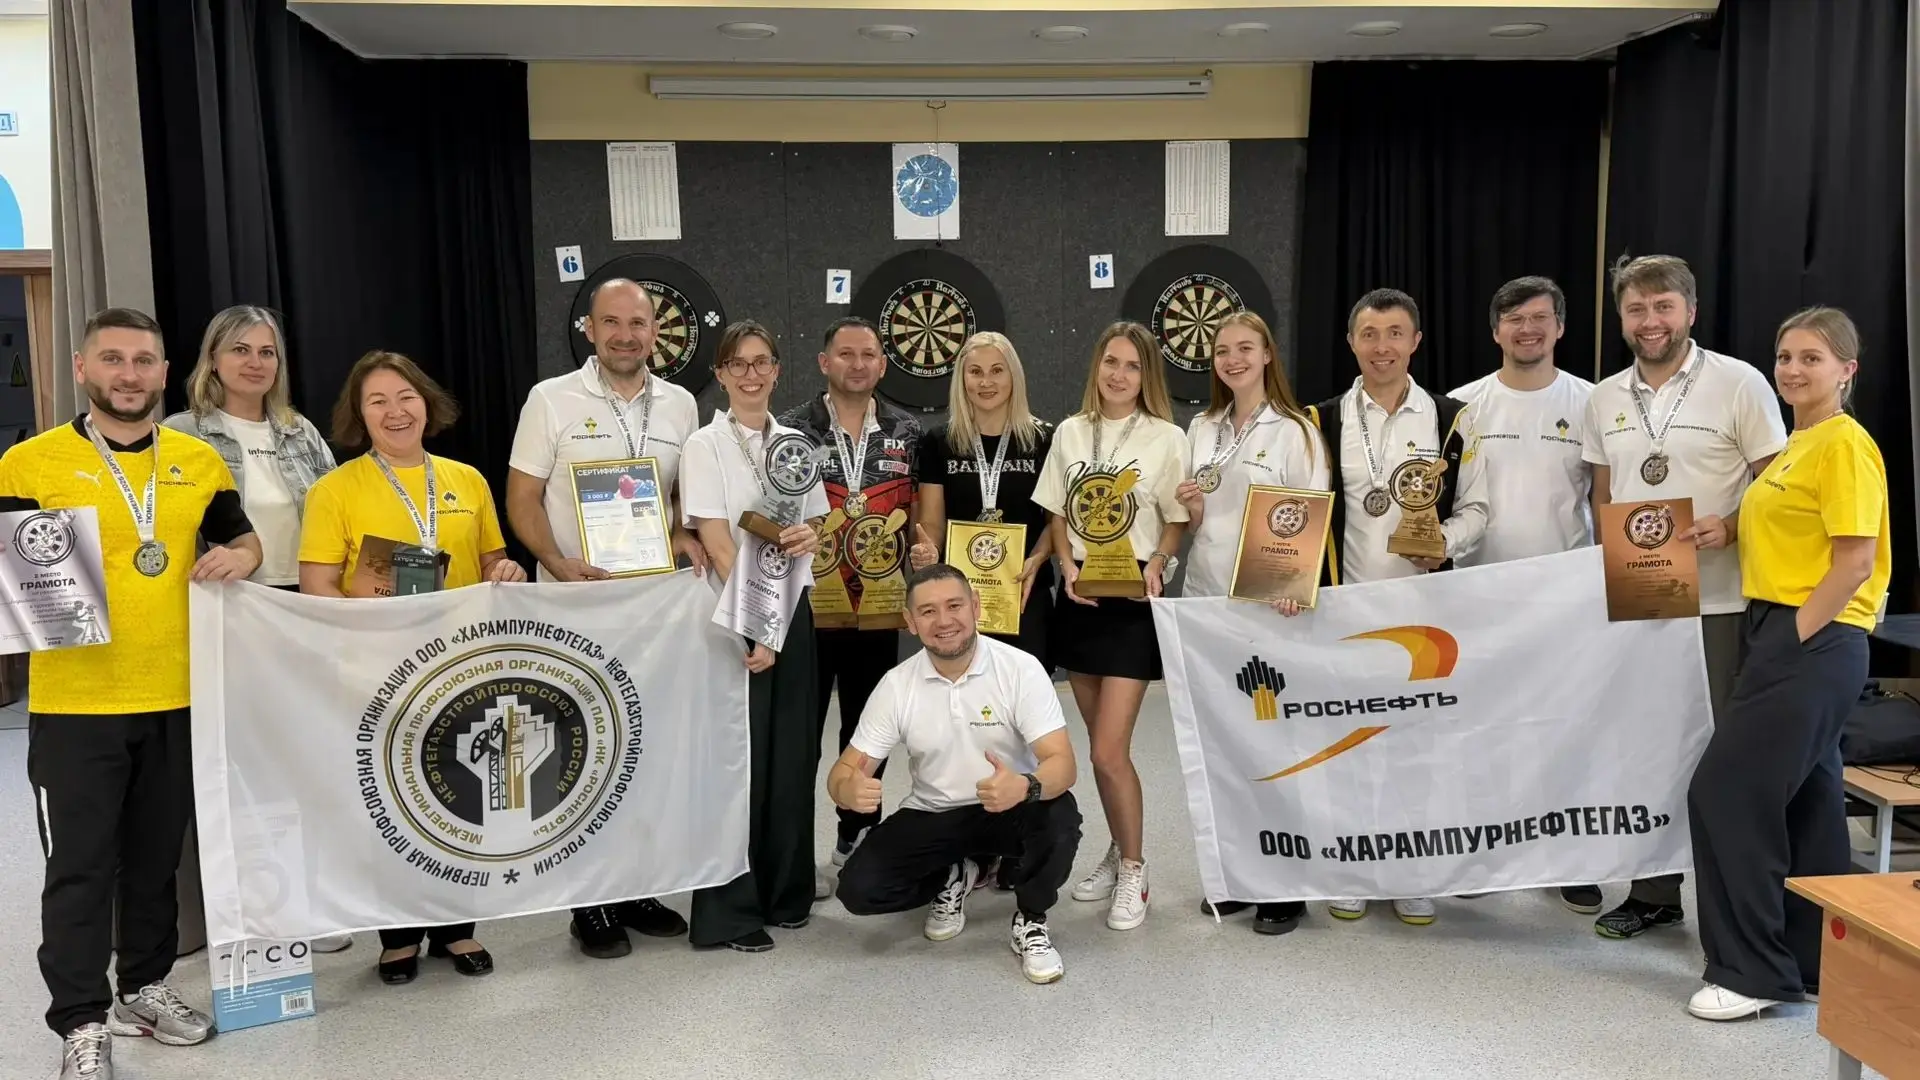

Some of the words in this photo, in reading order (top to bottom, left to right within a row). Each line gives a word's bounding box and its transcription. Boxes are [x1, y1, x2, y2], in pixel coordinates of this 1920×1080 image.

[563, 255, 579, 274] 6
[1094, 261, 1109, 279] 8
[832, 276, 846, 294] 7
[935, 282, 968, 310] Harrows
[1162, 278, 1193, 304] Harrows
[881, 299, 899, 336] Harrows
[610, 399, 622, 417] ДАРТС
[1659, 413, 1675, 439] ТЮМЕНЬ
[1680, 377, 1694, 398] ДАРТС
[638, 434, 646, 457] ЮМЕНЬ
[883, 438, 905, 450] FIX
[105, 453, 123, 475] ДАРТС
[576, 465, 630, 476] СЕРТИФИКАТ
[745, 448, 757, 467] ДАРТС
[786, 455, 801, 473] 2
[117, 475, 130, 492] 2026
[1411, 476, 1423, 491] 3
[127, 492, 143, 525] ТЮМЕНЬ
[633, 505, 657, 513] OZON
[1261, 545, 1299, 556] ГРАМОТА
[1626, 559, 1673, 569] ГРАМОТА
[20, 578, 76, 591] ГРАМОТА
[746, 579, 780, 600] ГРАМОТА
[967, 577, 1002, 586] ГРАМОТА
[415, 637, 447, 663] ООО
[451, 619, 605, 661] «ХАРАМПУРНЕФТЕГАЗ»
[409, 660, 503, 730] ПРОФСОЮЗНАЯ
[508, 659, 597, 705] ОРГАНИЗАЦИЯ
[356, 658, 418, 742] ОРГАНИЗАЦИЯ
[1283, 692, 1458, 719] РОСНЕФТЬ
[590, 705, 606, 735] ПАО
[426, 682, 575, 803] НЕФТЕГАЗСТРОЙПРОФСОЮЗ
[556, 726, 583, 793] РОССИИ
[584, 657, 643, 835] НЕФТЕГАЗСТРОЙПРОФСОЮЗА
[594, 739, 607, 765] «НК
[356, 748, 411, 854] ПРОФСОЮЗНАЯ
[401, 731, 483, 845] МЕЖРЕГИОНАЛЬНАЯ
[533, 769, 599, 836] «РОСНЕФТЬ»
[1259, 830, 1312, 860] ООО
[1320, 804, 1671, 862] «ХАРАМПУРНЕФТЕГАЗ»
[406, 848, 490, 887] ПЕРВИЧНАЯ
[533, 834, 587, 876] РОССИИ
